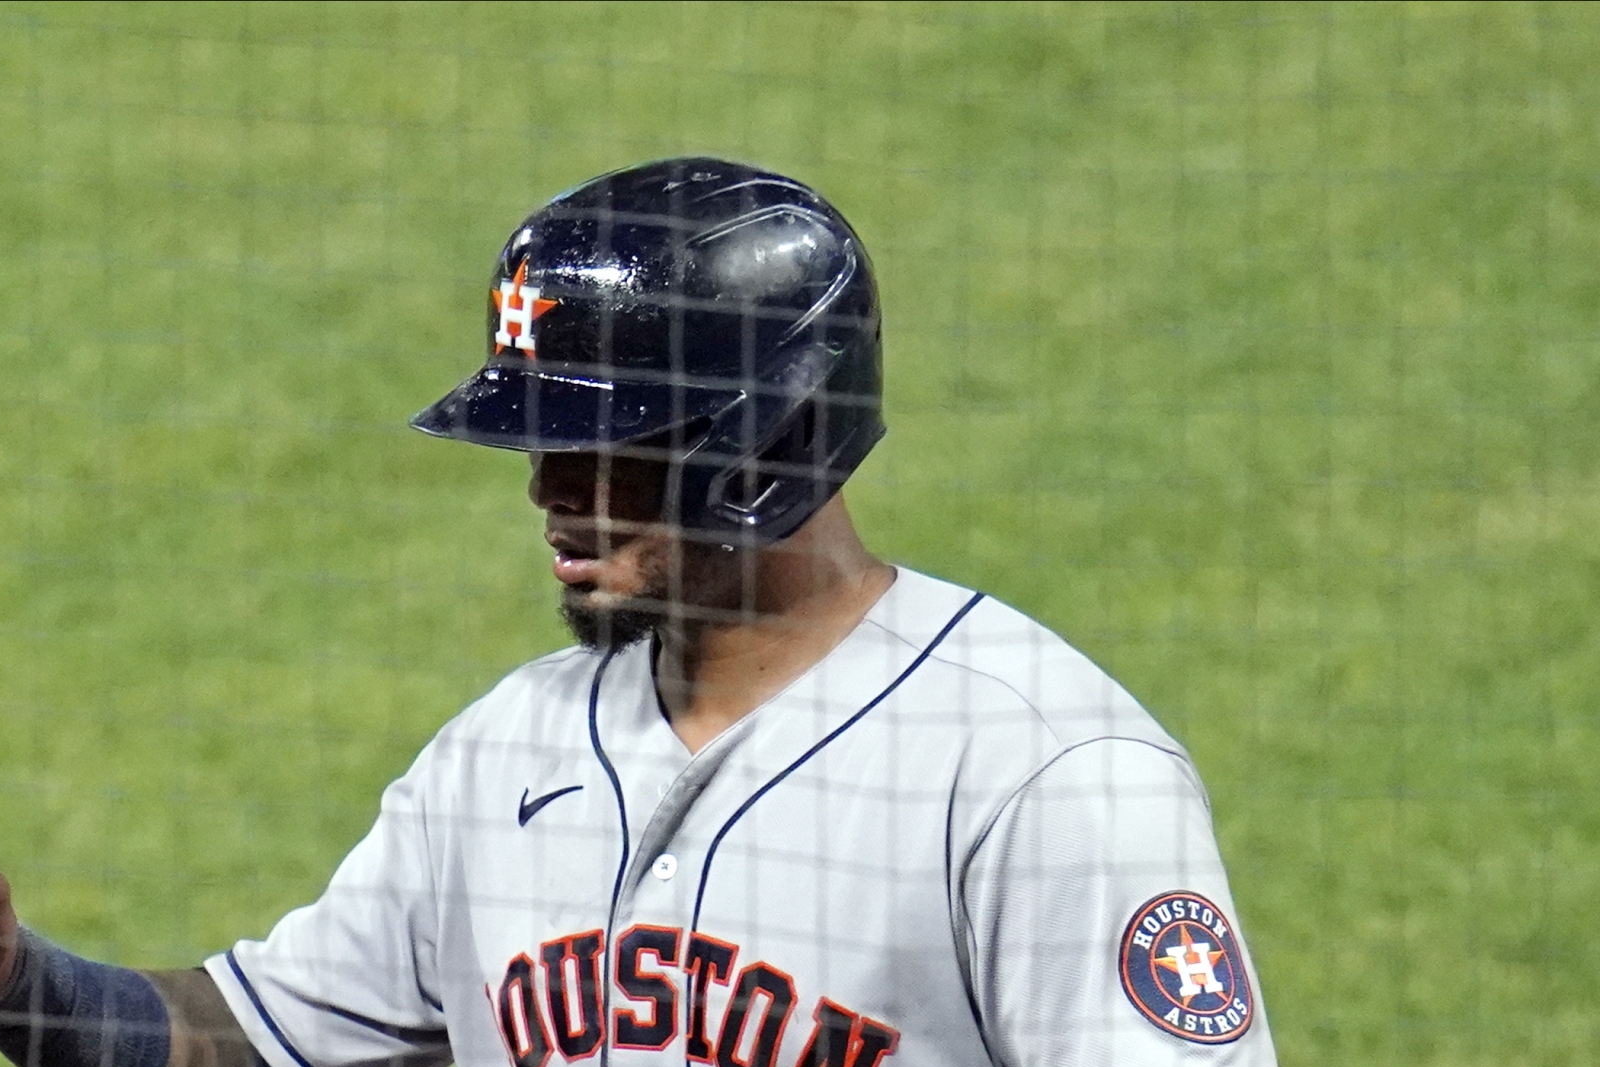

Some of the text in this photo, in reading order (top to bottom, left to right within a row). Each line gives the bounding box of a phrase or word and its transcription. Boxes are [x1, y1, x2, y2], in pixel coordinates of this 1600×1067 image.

[495, 280, 541, 351] H
[1133, 900, 1229, 950] HOUSTON
[1165, 942, 1224, 997] H
[1164, 998, 1248, 1035] ASTROS
